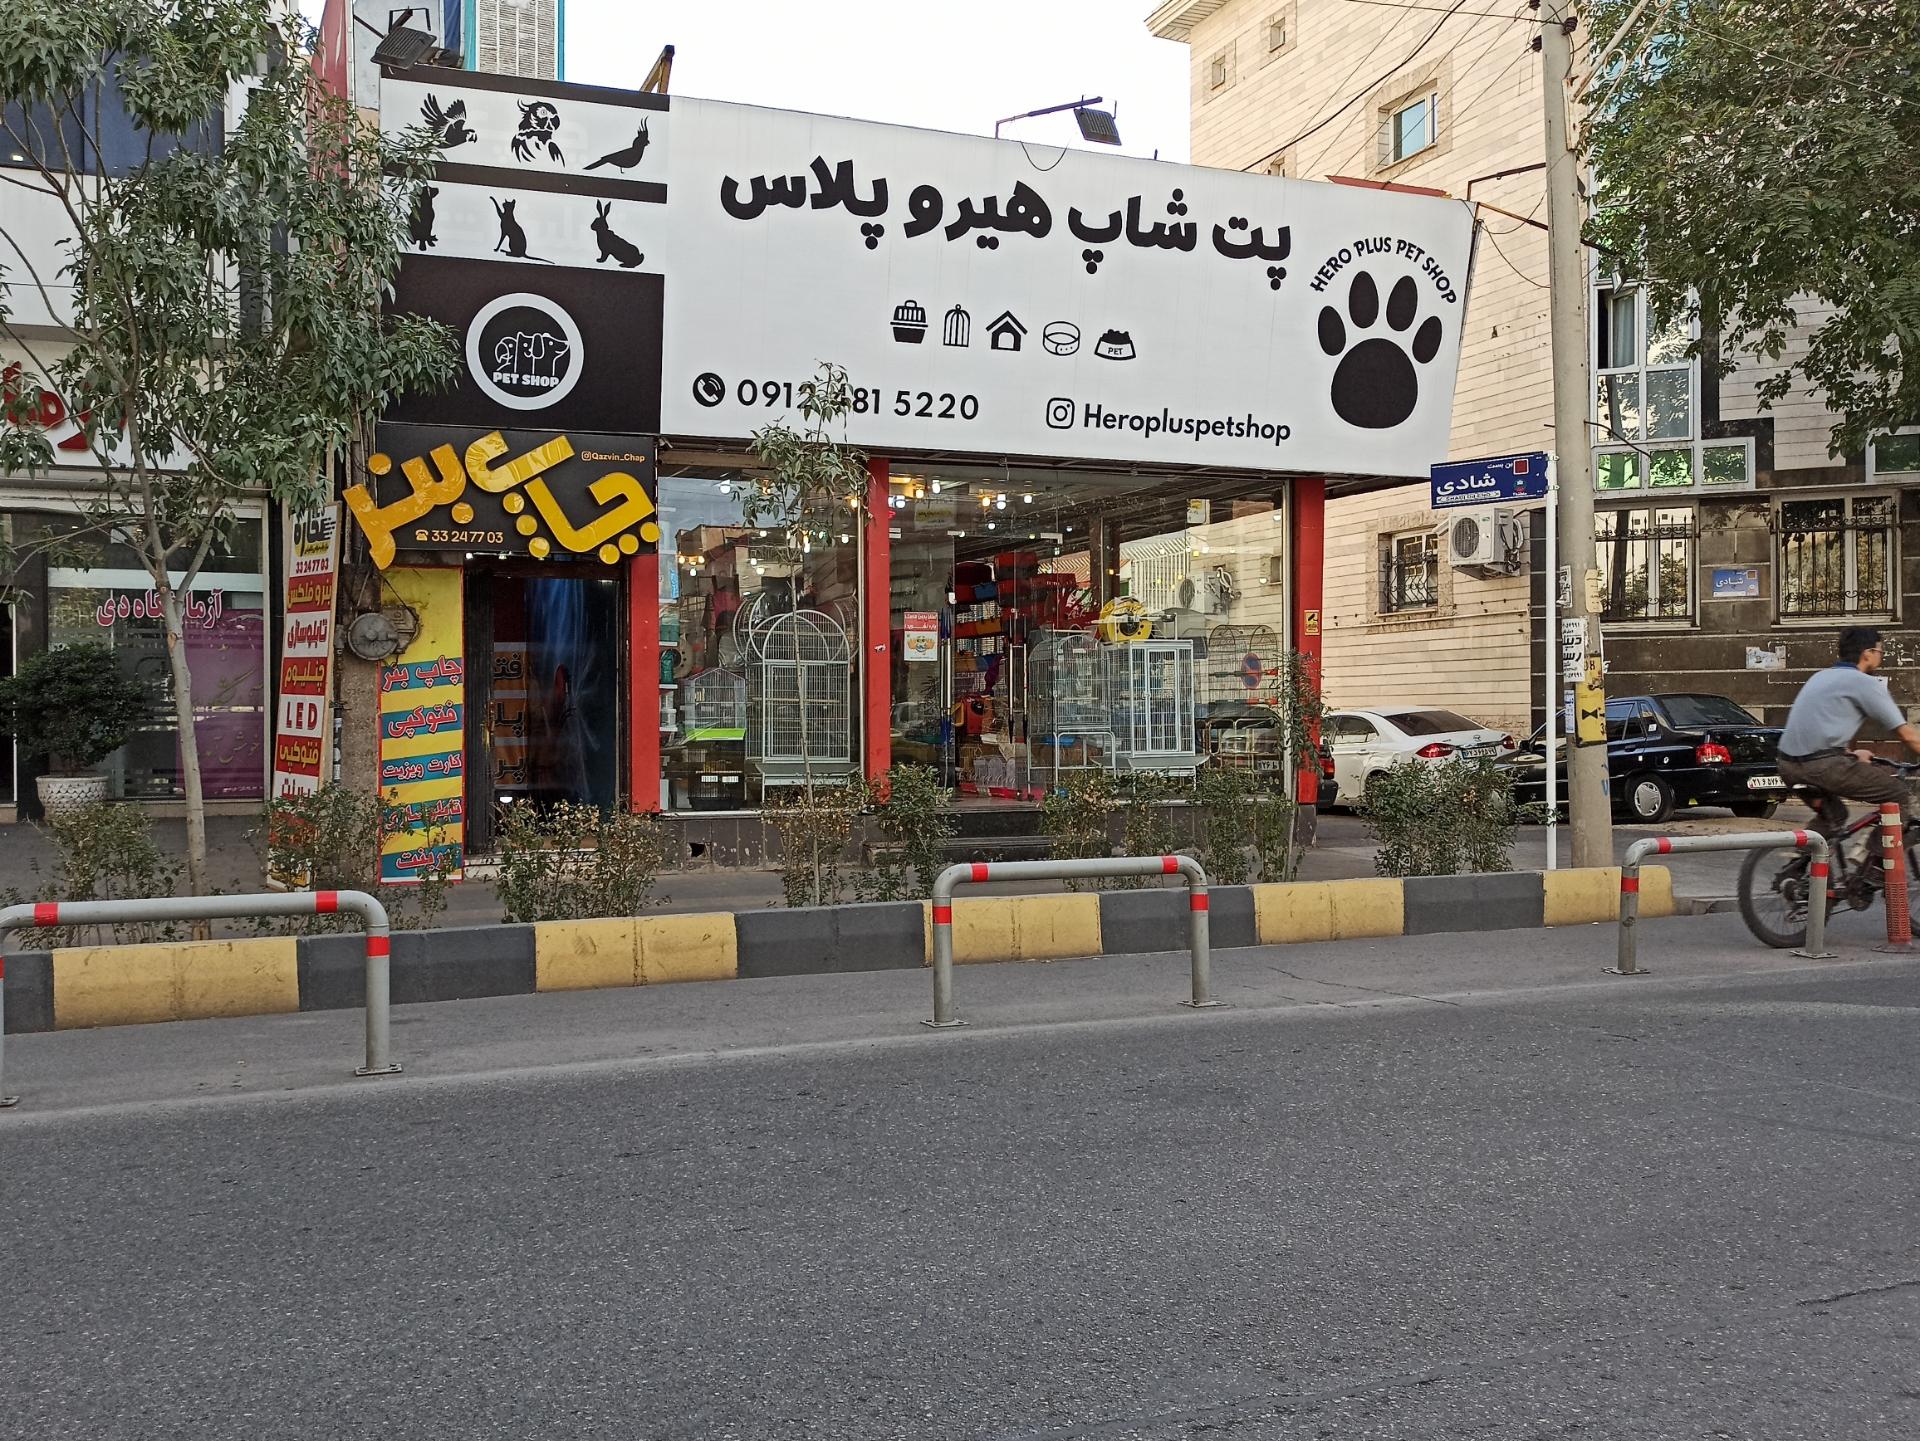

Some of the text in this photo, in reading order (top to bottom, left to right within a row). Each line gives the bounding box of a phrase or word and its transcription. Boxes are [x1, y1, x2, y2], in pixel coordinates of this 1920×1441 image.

[720, 155, 1292, 291] پت شاپ هیرو پلاس
[1309, 236, 1457, 304] HERO PLUS PET SHOP
[1107, 346, 1124, 356] PET
[492, 372, 560, 388] PET SHOP
[893, 390, 980, 420] 5220
[1083, 402, 1291, 447] Heropluspetshop
[464, 430, 661, 565] چاپ
[1436, 473, 1496, 496] شادی
[1715, 577, 1744, 587] شادی
[96, 594, 131, 627] دی
[382, 655, 463, 692] چاپ بنر
[285, 701, 318, 731] LED
[387, 700, 459, 739] فتوکپی
[279, 740, 319, 772] فتوکپی
[382, 754, 462, 780] کارت ویزیت
